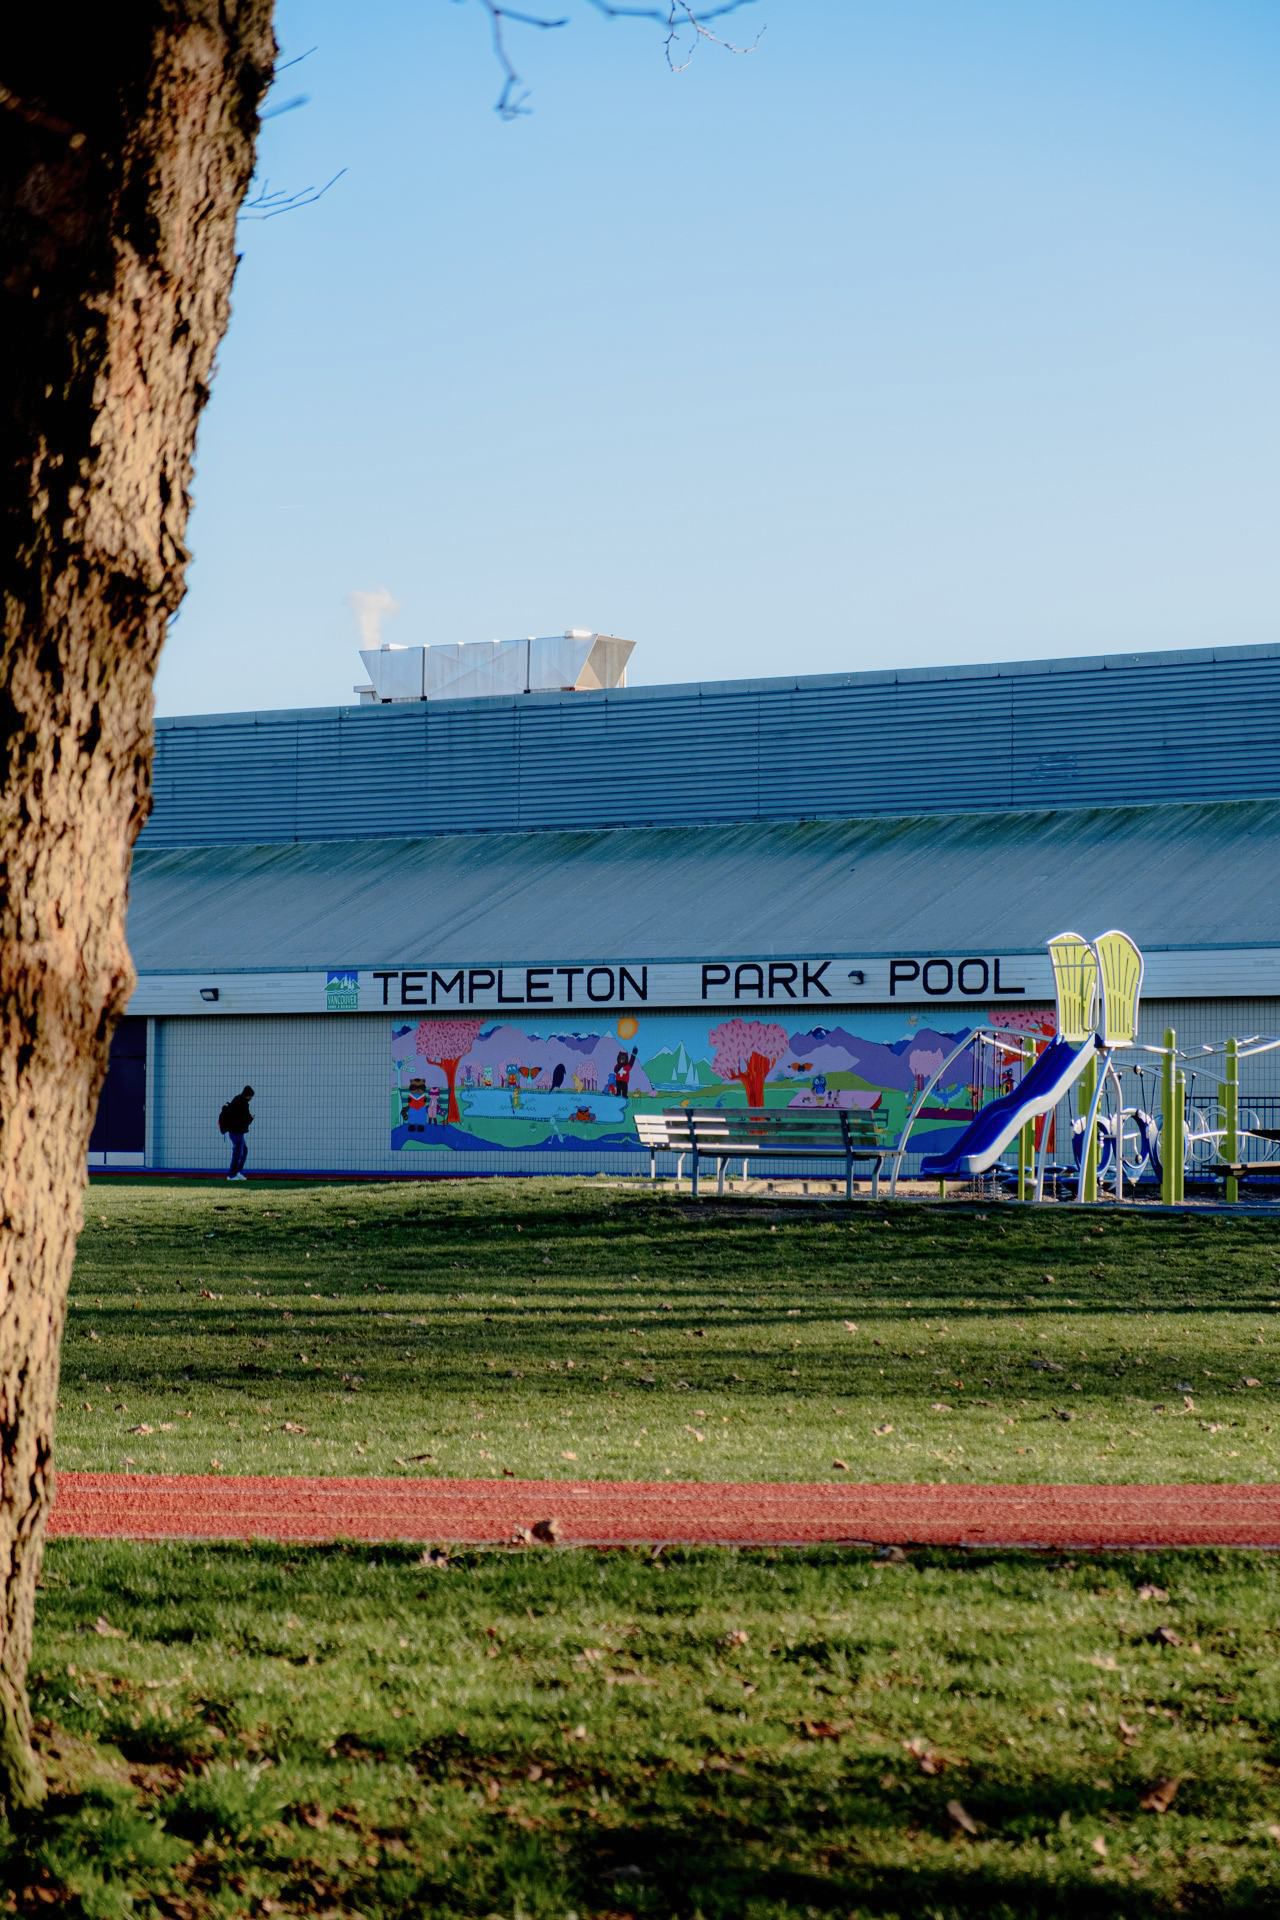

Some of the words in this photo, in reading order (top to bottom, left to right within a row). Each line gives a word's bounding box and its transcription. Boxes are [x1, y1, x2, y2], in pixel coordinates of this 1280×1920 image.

[373, 966, 647, 1005] TEMPLETON
[701, 960, 832, 999] PARK
[890, 957, 1025, 997] POOL
[328, 995, 357, 1005] VANCOUVER
